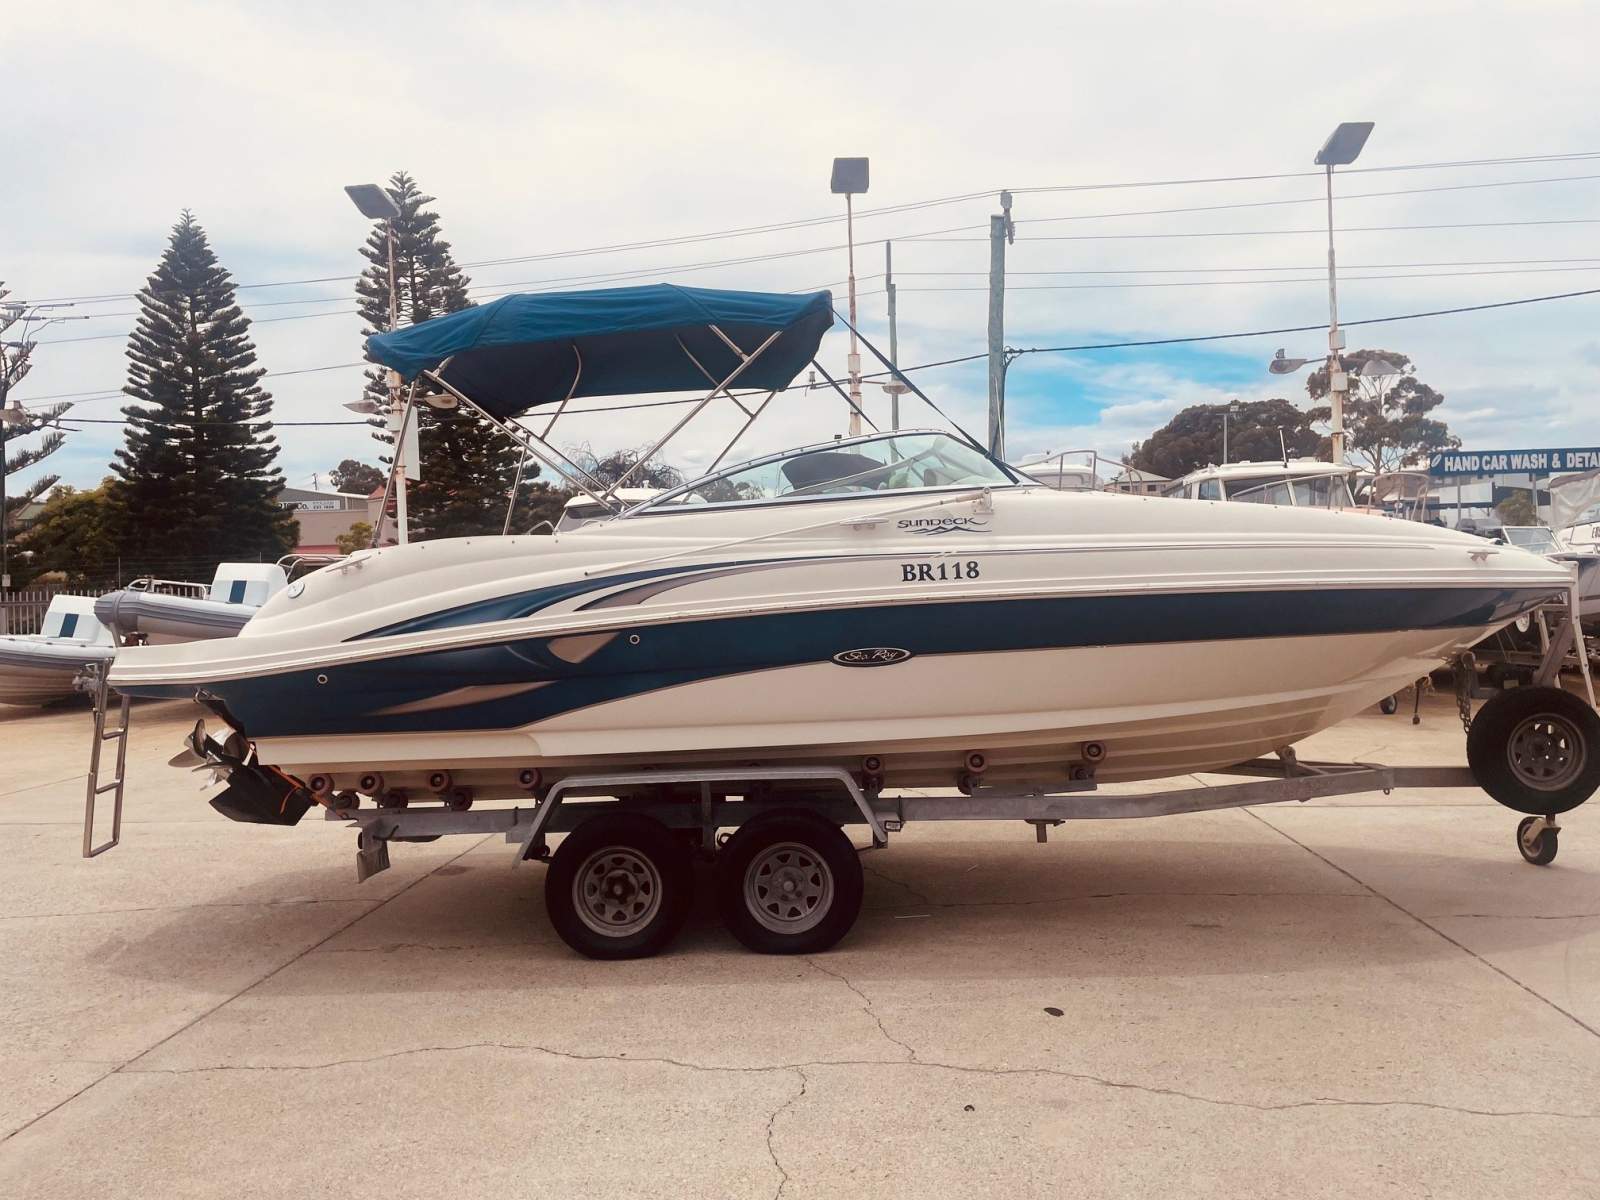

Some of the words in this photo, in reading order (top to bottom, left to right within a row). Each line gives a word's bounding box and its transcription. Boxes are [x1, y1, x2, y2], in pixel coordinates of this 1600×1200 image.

[1444, 455, 1480, 472] HAND
[1481, 454, 1508, 471] CAR
[1510, 453, 1548, 470] WASH
[1551, 452, 1561, 469] &
[901, 561, 980, 582] BR118
[844, 651, 869, 661] Sea
[871, 649, 898, 661] Ray
